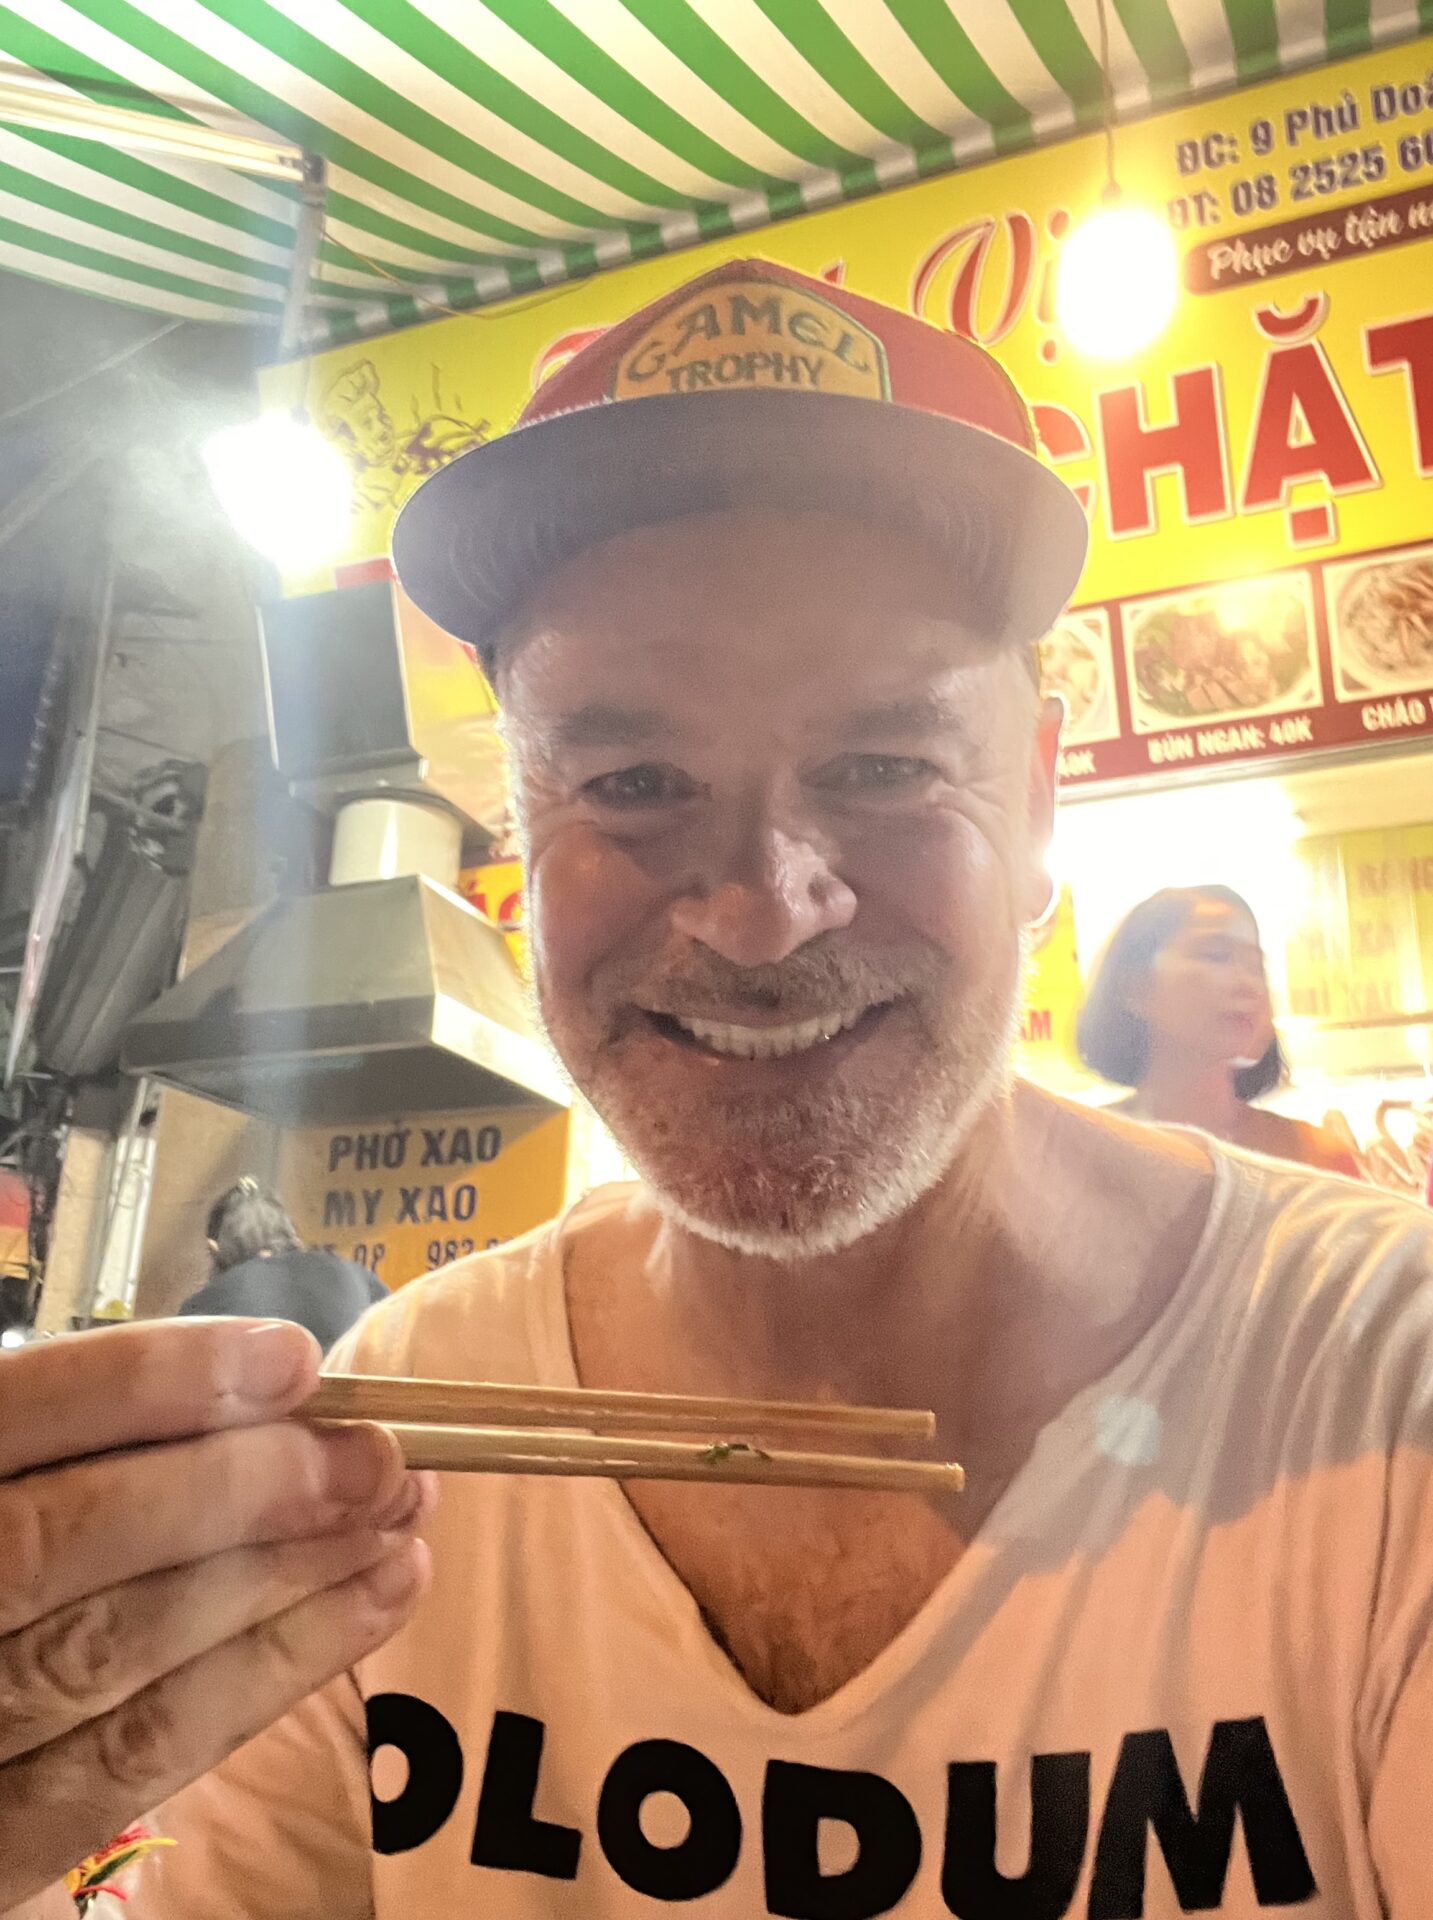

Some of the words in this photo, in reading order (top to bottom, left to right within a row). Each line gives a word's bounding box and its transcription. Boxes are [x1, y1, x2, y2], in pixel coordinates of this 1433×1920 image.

[1250, 119, 1273, 156] 9
[1231, 174, 1278, 216] 08
[1289, 143, 1386, 201] 2525
[1207, 238, 1293, 281] Phục
[1297, 228, 1342, 260] vụ
[615, 292, 874, 382] CAMEL
[665, 350, 826, 393] TROPHY
[1147, 731, 1195, 764] BÚN
[1196, 723, 1267, 757] NGAN:
[1269, 714, 1314, 746] 40K
[1361, 696, 1427, 732] CHÁO
[365, 1690, 1321, 1920] OLODUM
